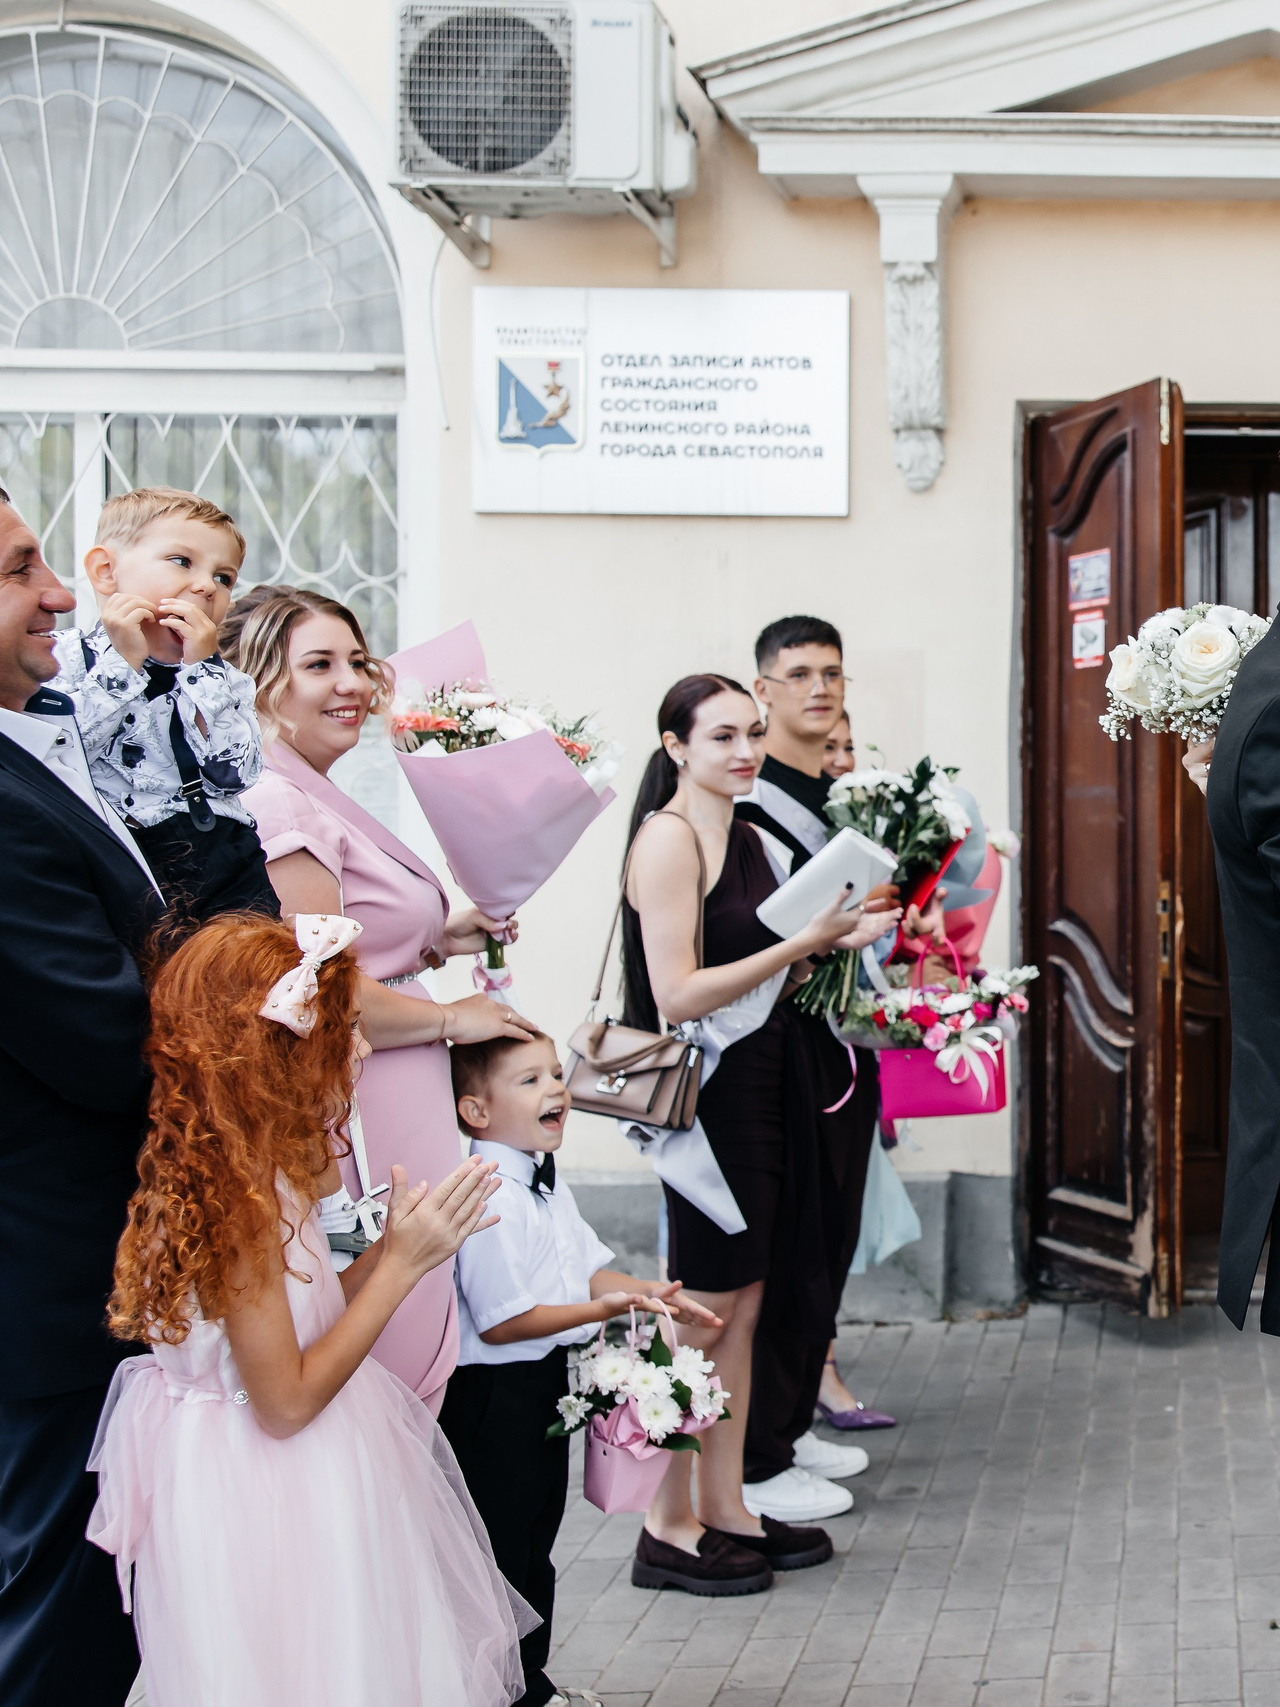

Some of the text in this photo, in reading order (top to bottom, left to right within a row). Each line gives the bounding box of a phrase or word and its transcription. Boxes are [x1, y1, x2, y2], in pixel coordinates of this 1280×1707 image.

[600, 353, 813, 370] ОТДЕЛ ЗАПИСИ АКТОВ
[600, 376, 758, 392] ГРАЖДАНСКОГО
[600, 398, 718, 412] СОСТОЯНИЯ
[600, 419, 811, 437] ЛЕНИНСКОГО РАЙОНА
[600, 443, 824, 459] ГОРОДА СЕВАСТОПОЛЯ
